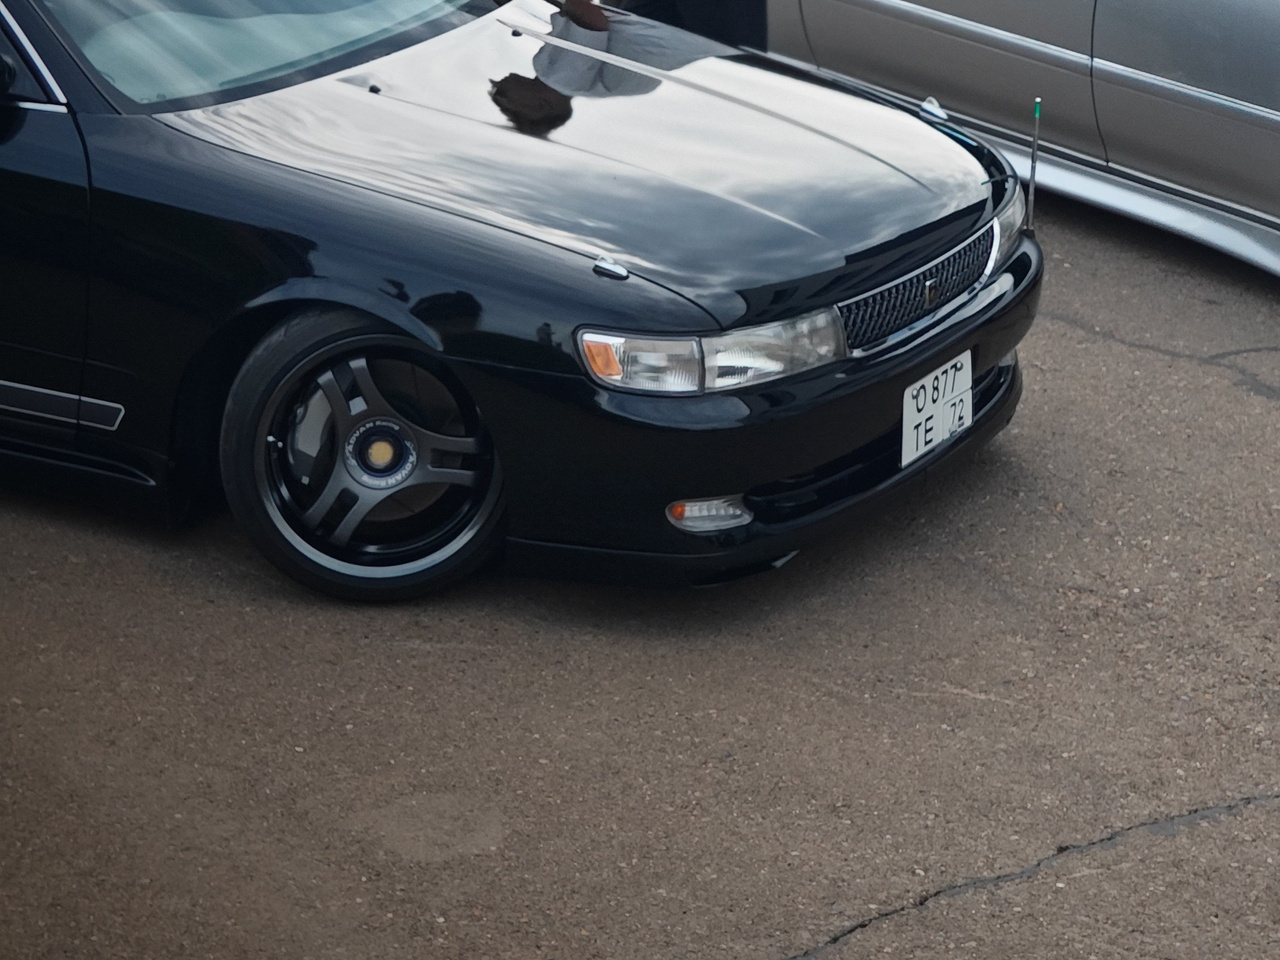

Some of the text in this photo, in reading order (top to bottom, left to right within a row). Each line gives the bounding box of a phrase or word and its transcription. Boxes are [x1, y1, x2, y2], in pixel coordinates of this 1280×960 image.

[932, 361, 961, 404] 877
[347, 422, 374, 452] ADVAN
[913, 398, 964, 452] ТЕ 72
